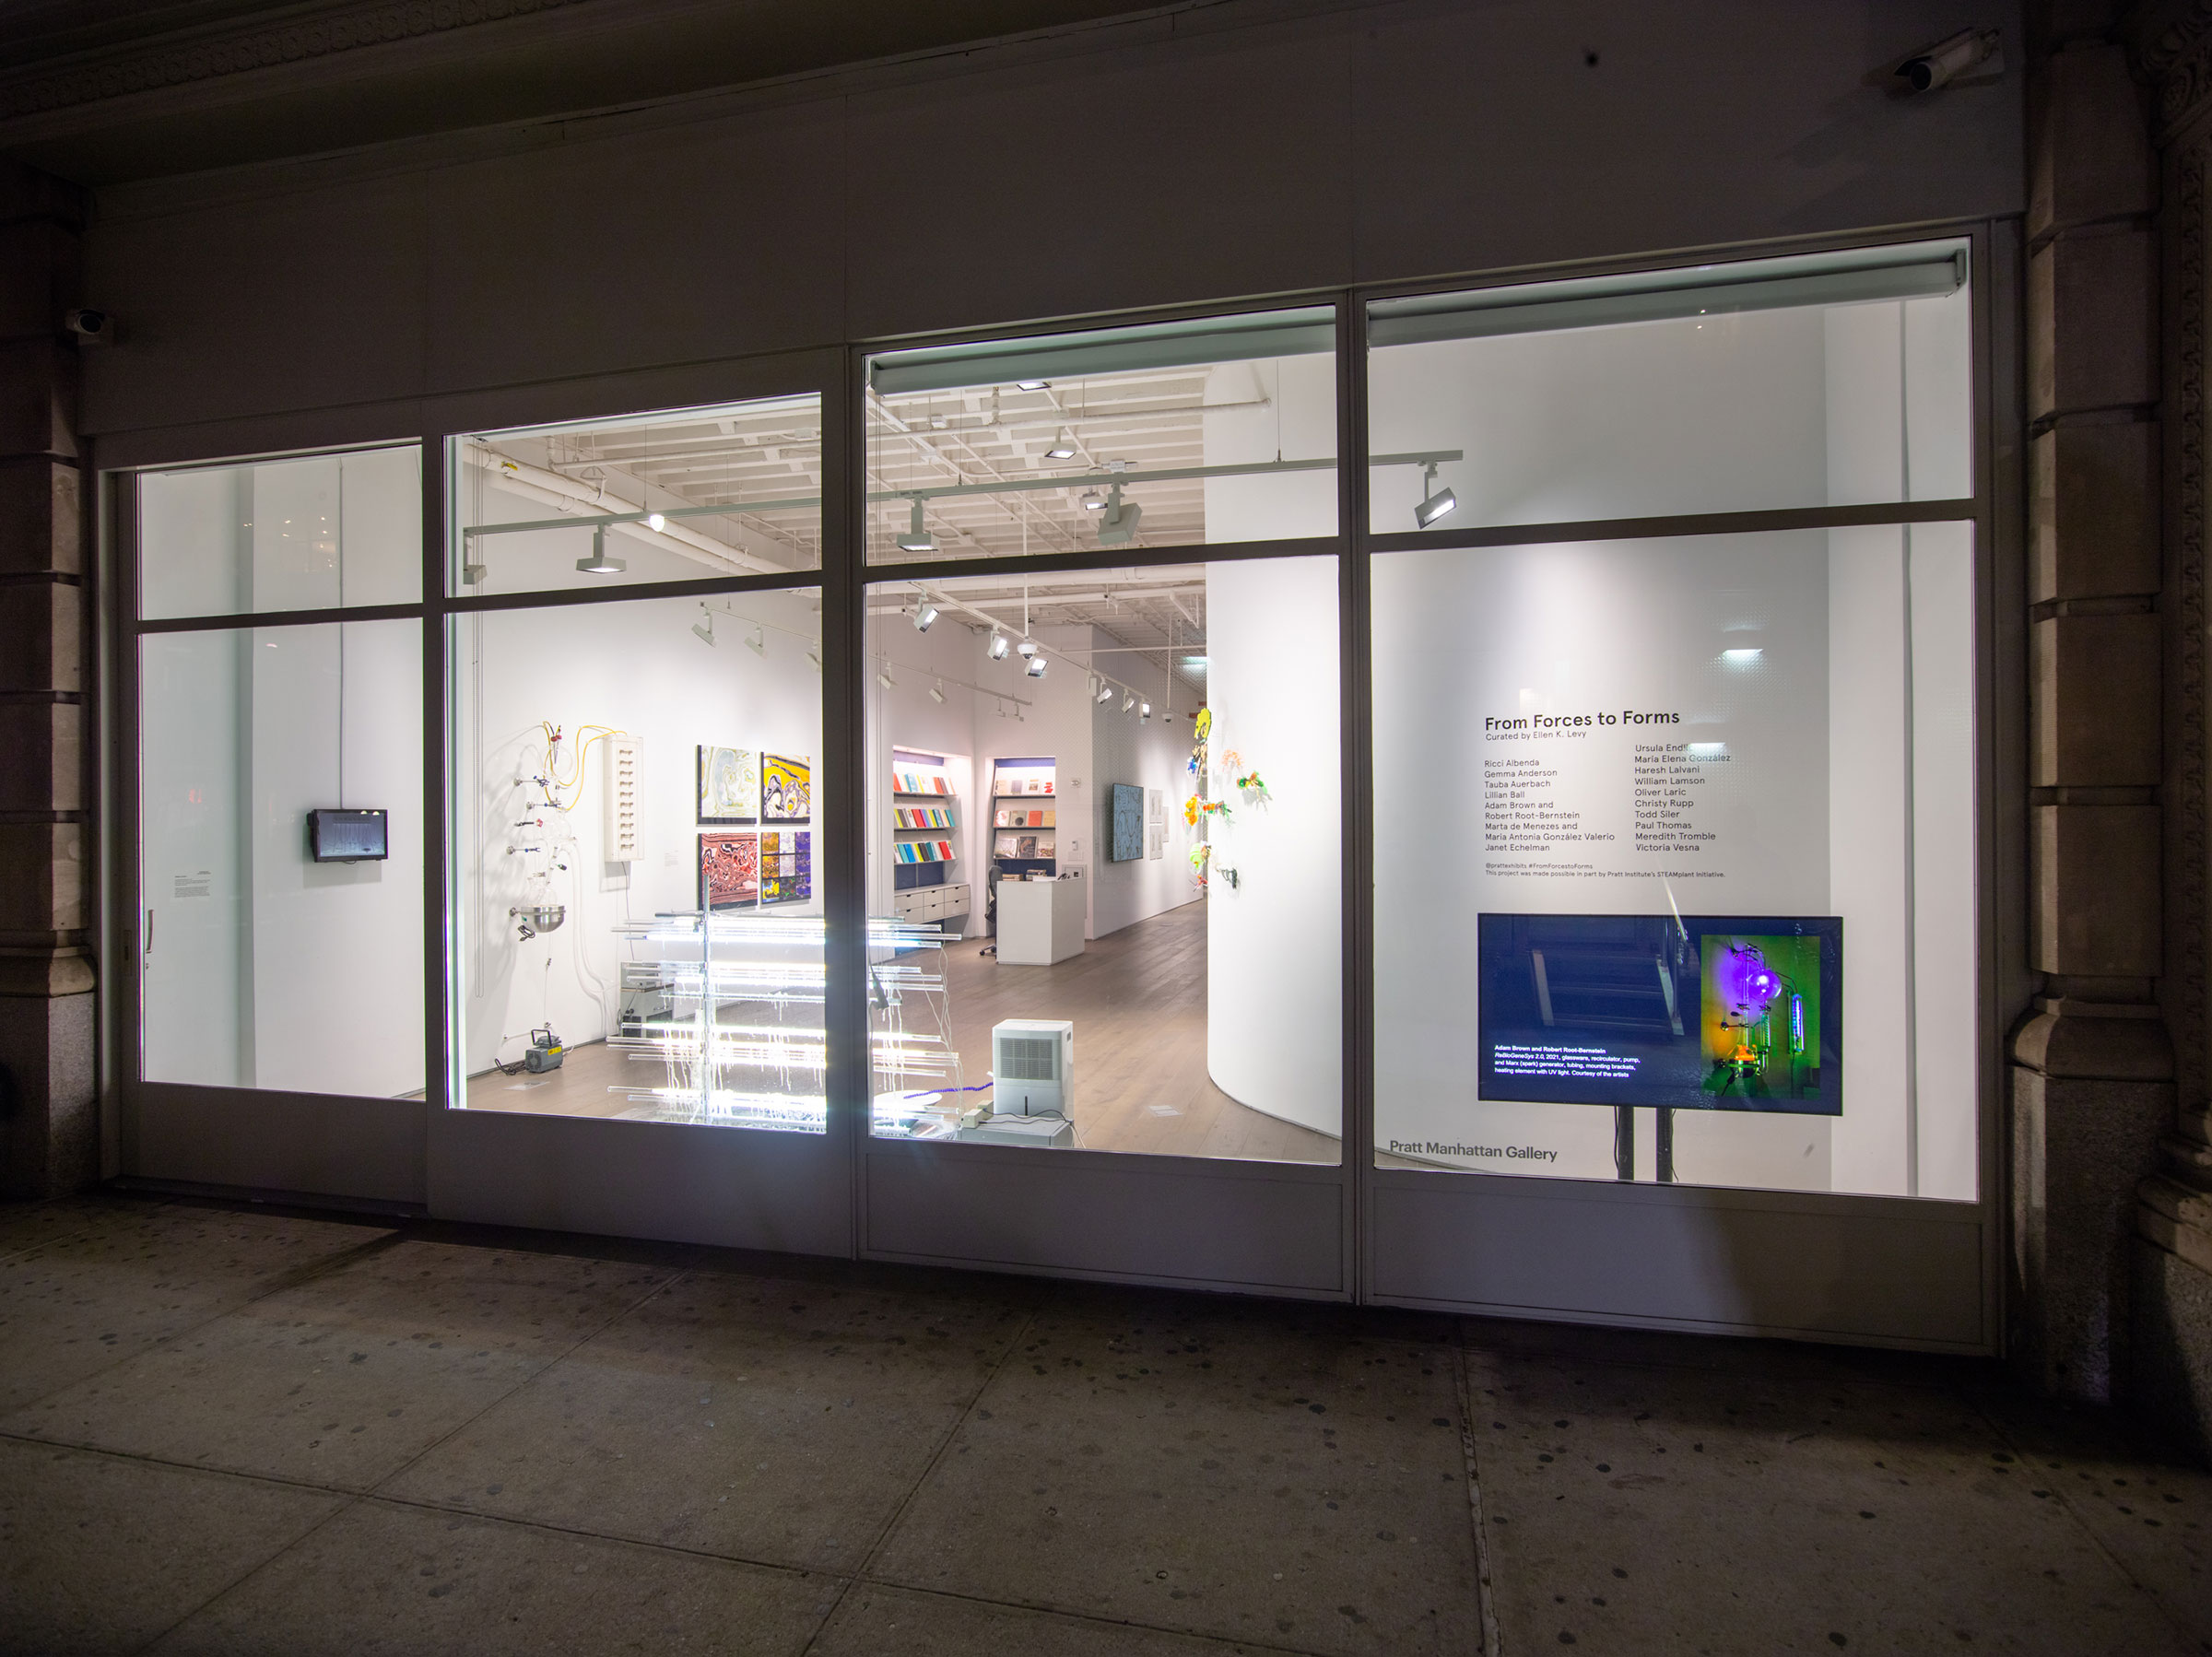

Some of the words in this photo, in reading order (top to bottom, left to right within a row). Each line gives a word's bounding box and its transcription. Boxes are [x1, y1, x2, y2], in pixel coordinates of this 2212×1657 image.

[1486, 717, 1527, 731] From
[1534, 715, 1592, 728] Forces
[1597, 712, 1617, 725] to
[1623, 711, 1679, 724] Forms
[1486, 732, 1518, 741] Curated
[1521, 732, 1531, 740] by
[1533, 731, 1553, 739] Ellen
[1568, 730, 1586, 738] Levy
[1635, 744, 1664, 752] Ursula
[1688, 754, 1731, 762] González
[1506, 758, 1539, 767] Albenda
[1518, 769, 1558, 777] Anderson
[1635, 766, 1666, 774] Haresh
[1511, 780, 1551, 788] Auerbach
[1634, 777, 1667, 785] William
[1670, 777, 1705, 785] Lamson
[1511, 791, 1524, 799] Ball
[1635, 788, 1662, 796] Oliver
[1664, 788, 1686, 796] Laric
[1635, 800, 1667, 808] Christy
[1670, 800, 1694, 808] Rupp
[1515, 811, 1580, 819] Root-Bernstein
[1635, 810, 1656, 818] Todd
[1660, 810, 1679, 818] Siler
[1635, 821, 1654, 829] Paul
[1657, 821, 1691, 829] Thomas
[1543, 832, 1583, 840] González
[1635, 832, 1676, 840] Meredith
[1678, 832, 1715, 840] Tromble
[1636, 843, 1670, 852] Victoria
[1390, 1140, 1422, 1153] Pratt
[1427, 1142, 1502, 1158] Manhattan
[1506, 1146, 1558, 1163] Gallery
